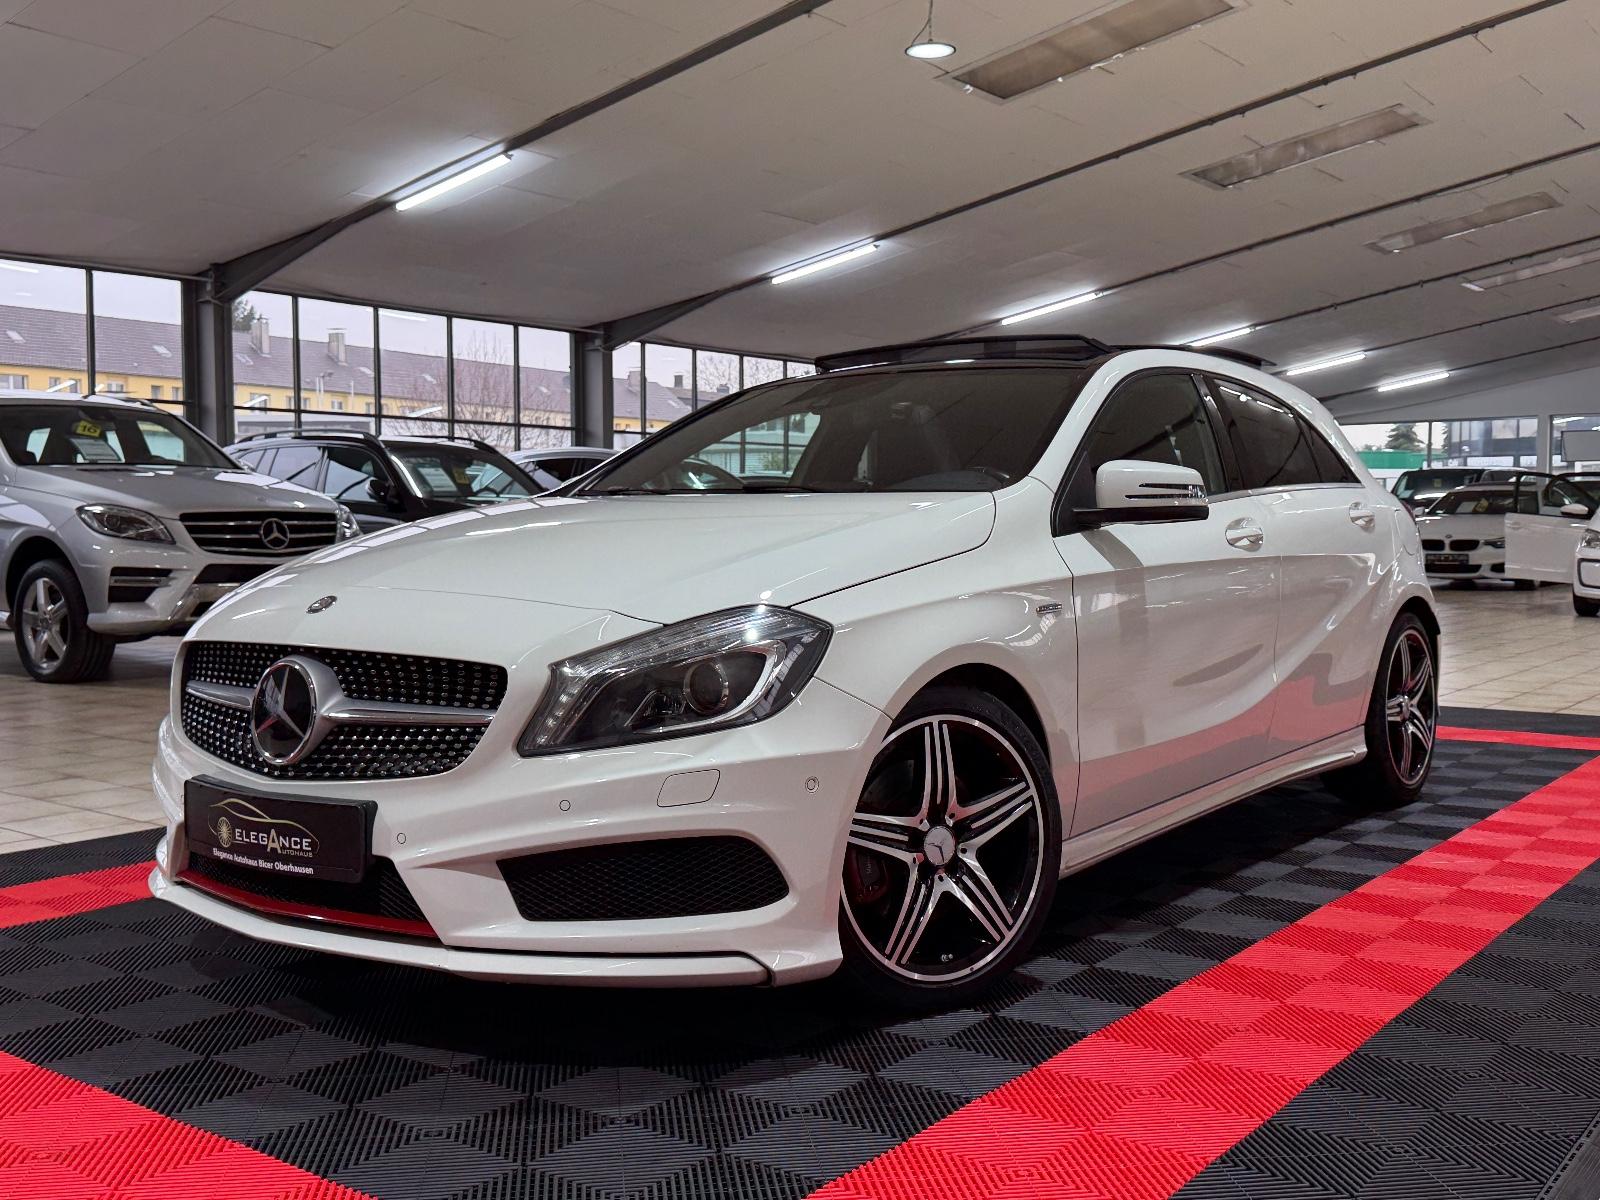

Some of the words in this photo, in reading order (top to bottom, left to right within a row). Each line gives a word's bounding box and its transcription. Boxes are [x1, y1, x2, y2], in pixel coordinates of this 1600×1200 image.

[81, 424, 97, 434] 16
[235, 828, 312, 853] ELEGANCE
[213, 847, 233, 860] Elegance
[234, 853, 258, 866] Autohaus
[274, 861, 314, 874] Oberhausen
